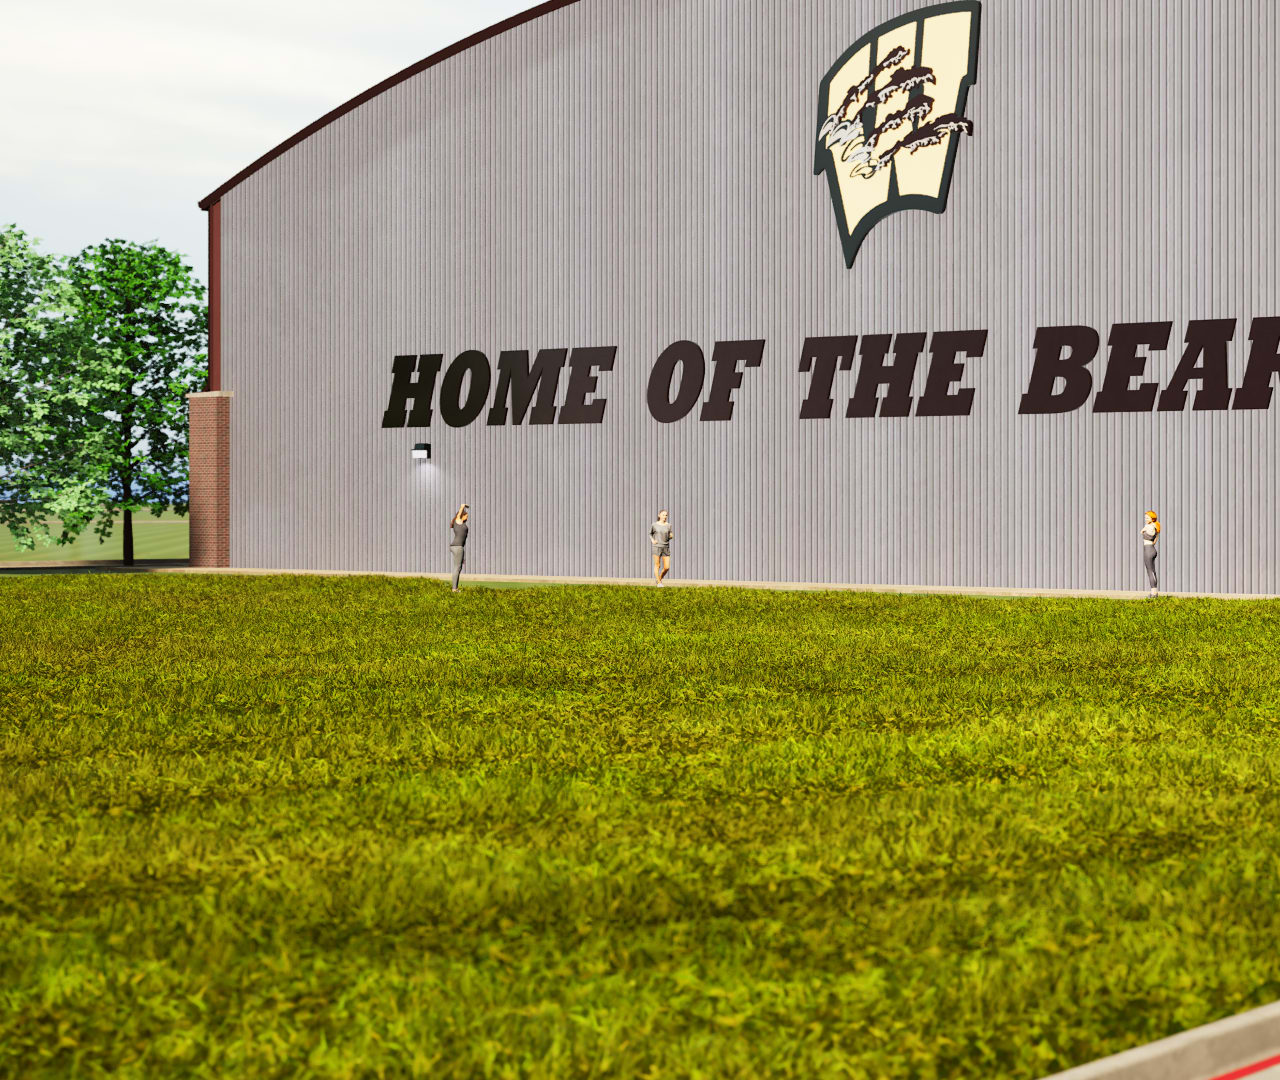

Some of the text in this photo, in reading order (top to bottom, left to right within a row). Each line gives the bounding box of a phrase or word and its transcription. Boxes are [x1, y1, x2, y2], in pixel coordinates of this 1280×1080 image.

[382, 346, 617, 428] HOME
[647, 340, 765, 423] OF
[799, 330, 988, 419] THE
